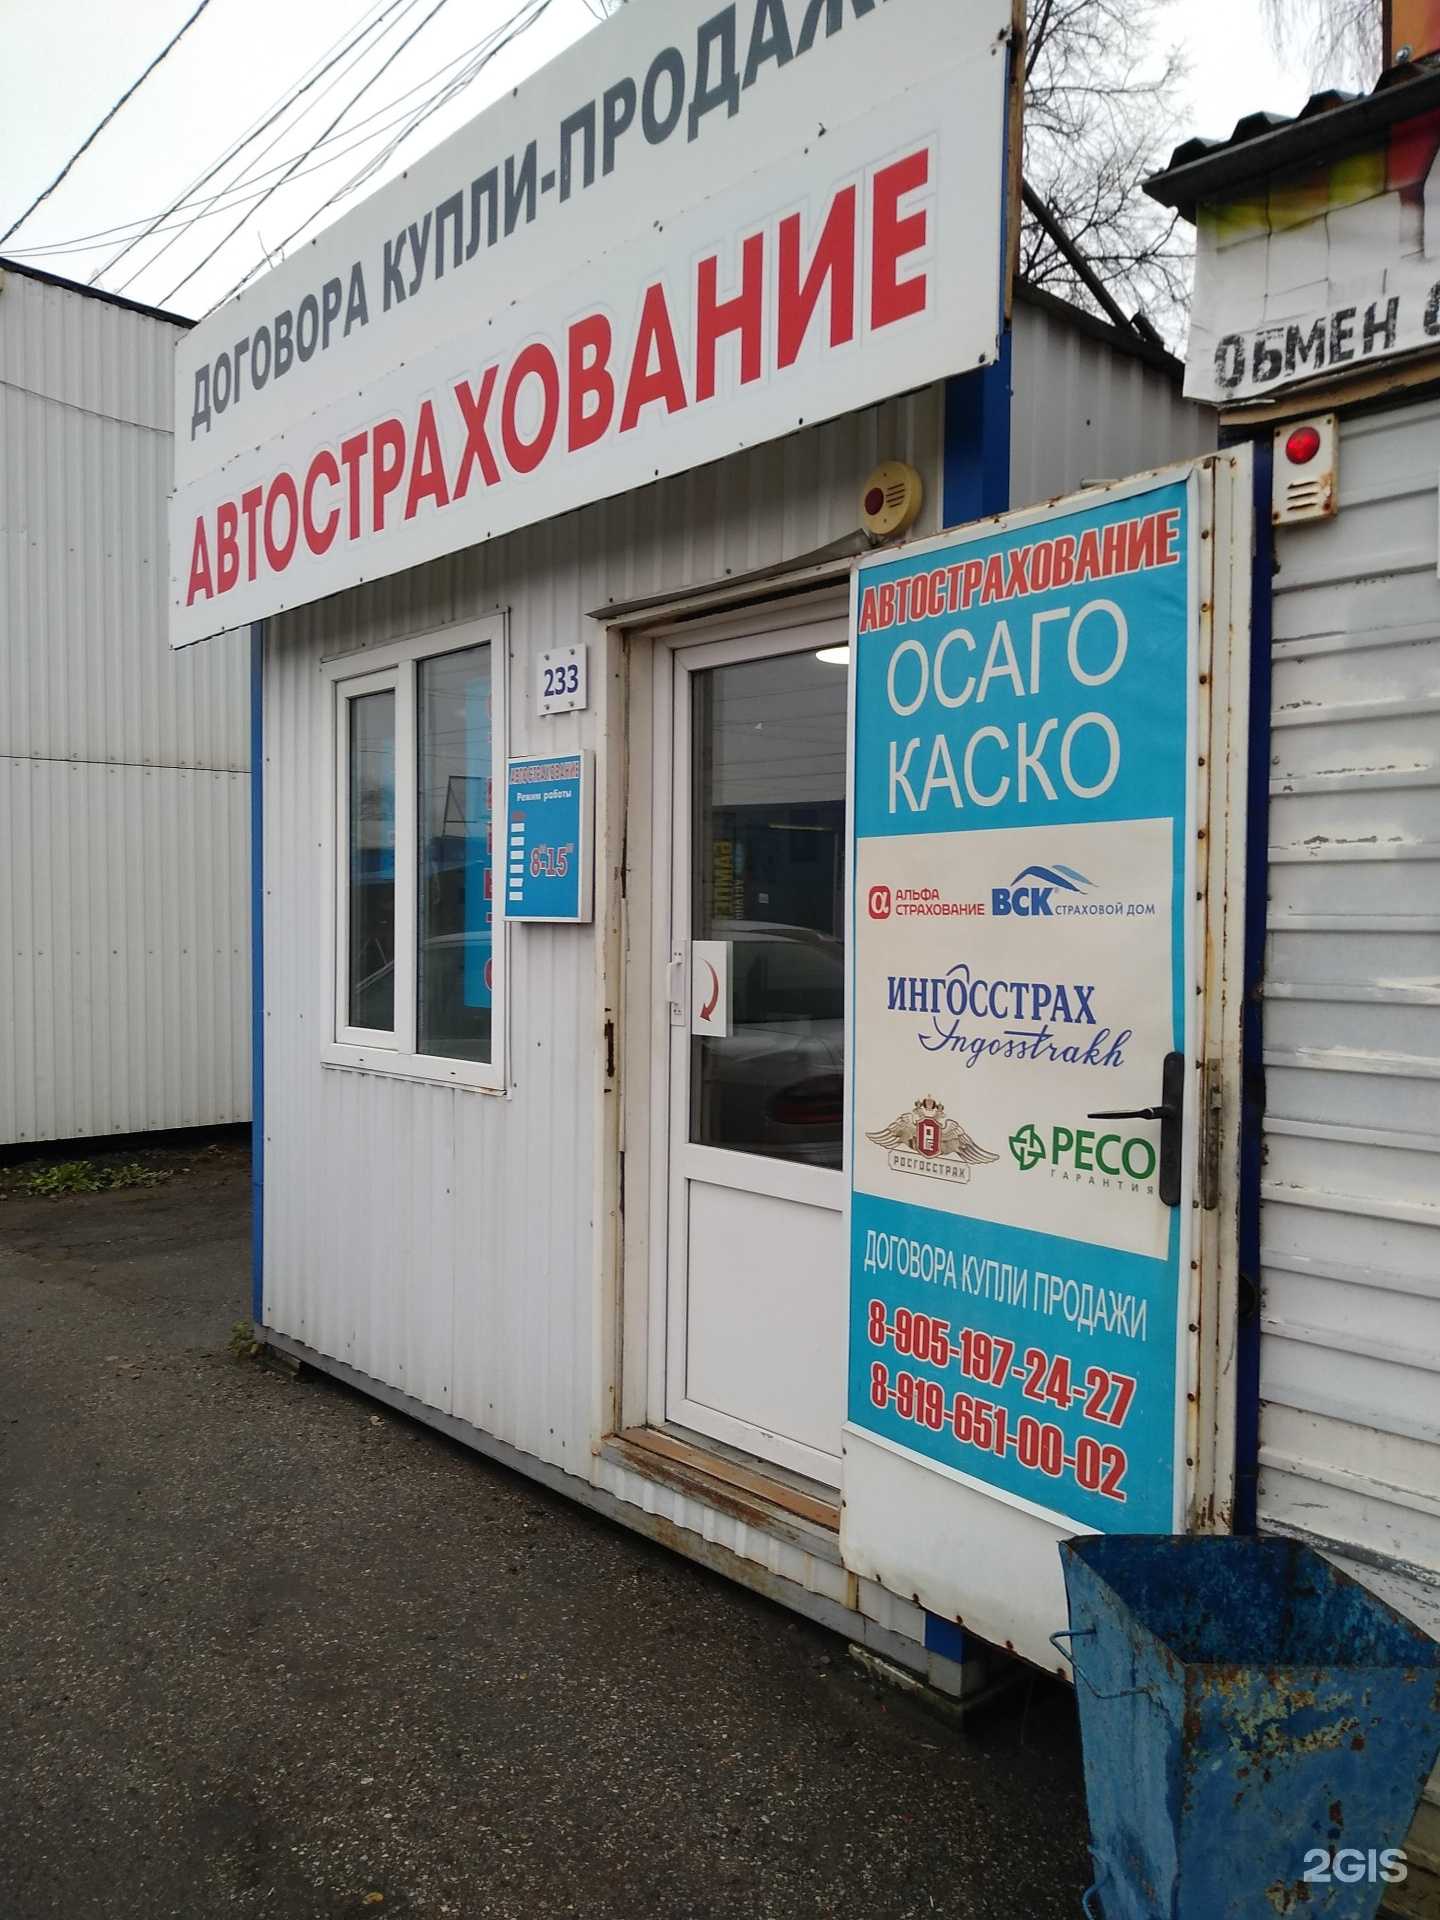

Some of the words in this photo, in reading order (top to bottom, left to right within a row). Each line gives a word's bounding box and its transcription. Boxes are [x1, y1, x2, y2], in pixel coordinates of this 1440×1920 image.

[191, 261, 369, 441] ДОГОВОРА
[382, 0, 890, 314] КУПЛИ-ПРОДА
[186, 148, 929, 607] АВТОСТРАХОВАНИЕ
[1214, 296, 1400, 389] ОБМЕН
[858, 507, 1181, 634] АВТОСТРАХОВАНИЕ
[543, 664, 579, 698] 233
[887, 599, 1128, 716] ОСАГО
[543, 789, 572, 802] работы
[889, 711, 1121, 814] КАСКО
[896, 888, 940, 901] АЛЬФА
[896, 904, 985, 916] СТРАХОВАНИЕ
[992, 887, 1054, 916] ВСК
[1055, 902, 1123, 916] СТРАХОВОЙ
[1126, 904, 1156, 916] ДОМ
[887, 964, 1097, 1025] ИНГОССТРАХ
[918, 1016, 1133, 1069] Ingosstrakh
[1050, 1168, 1154, 1195] ГАРАНТИЯ
[1051, 1126, 1156, 1180] РЕСО
[864, 1229, 957, 1290] ДОГОВОРА
[961, 1254, 1028, 1309] КУПЛИ
[1033, 1271, 1148, 1342] ПРОДАЖИ
[868, 1298, 1137, 1429] 8-905-197-24-27
[870, 1361, 1128, 1503] 8-919-651-00-02
